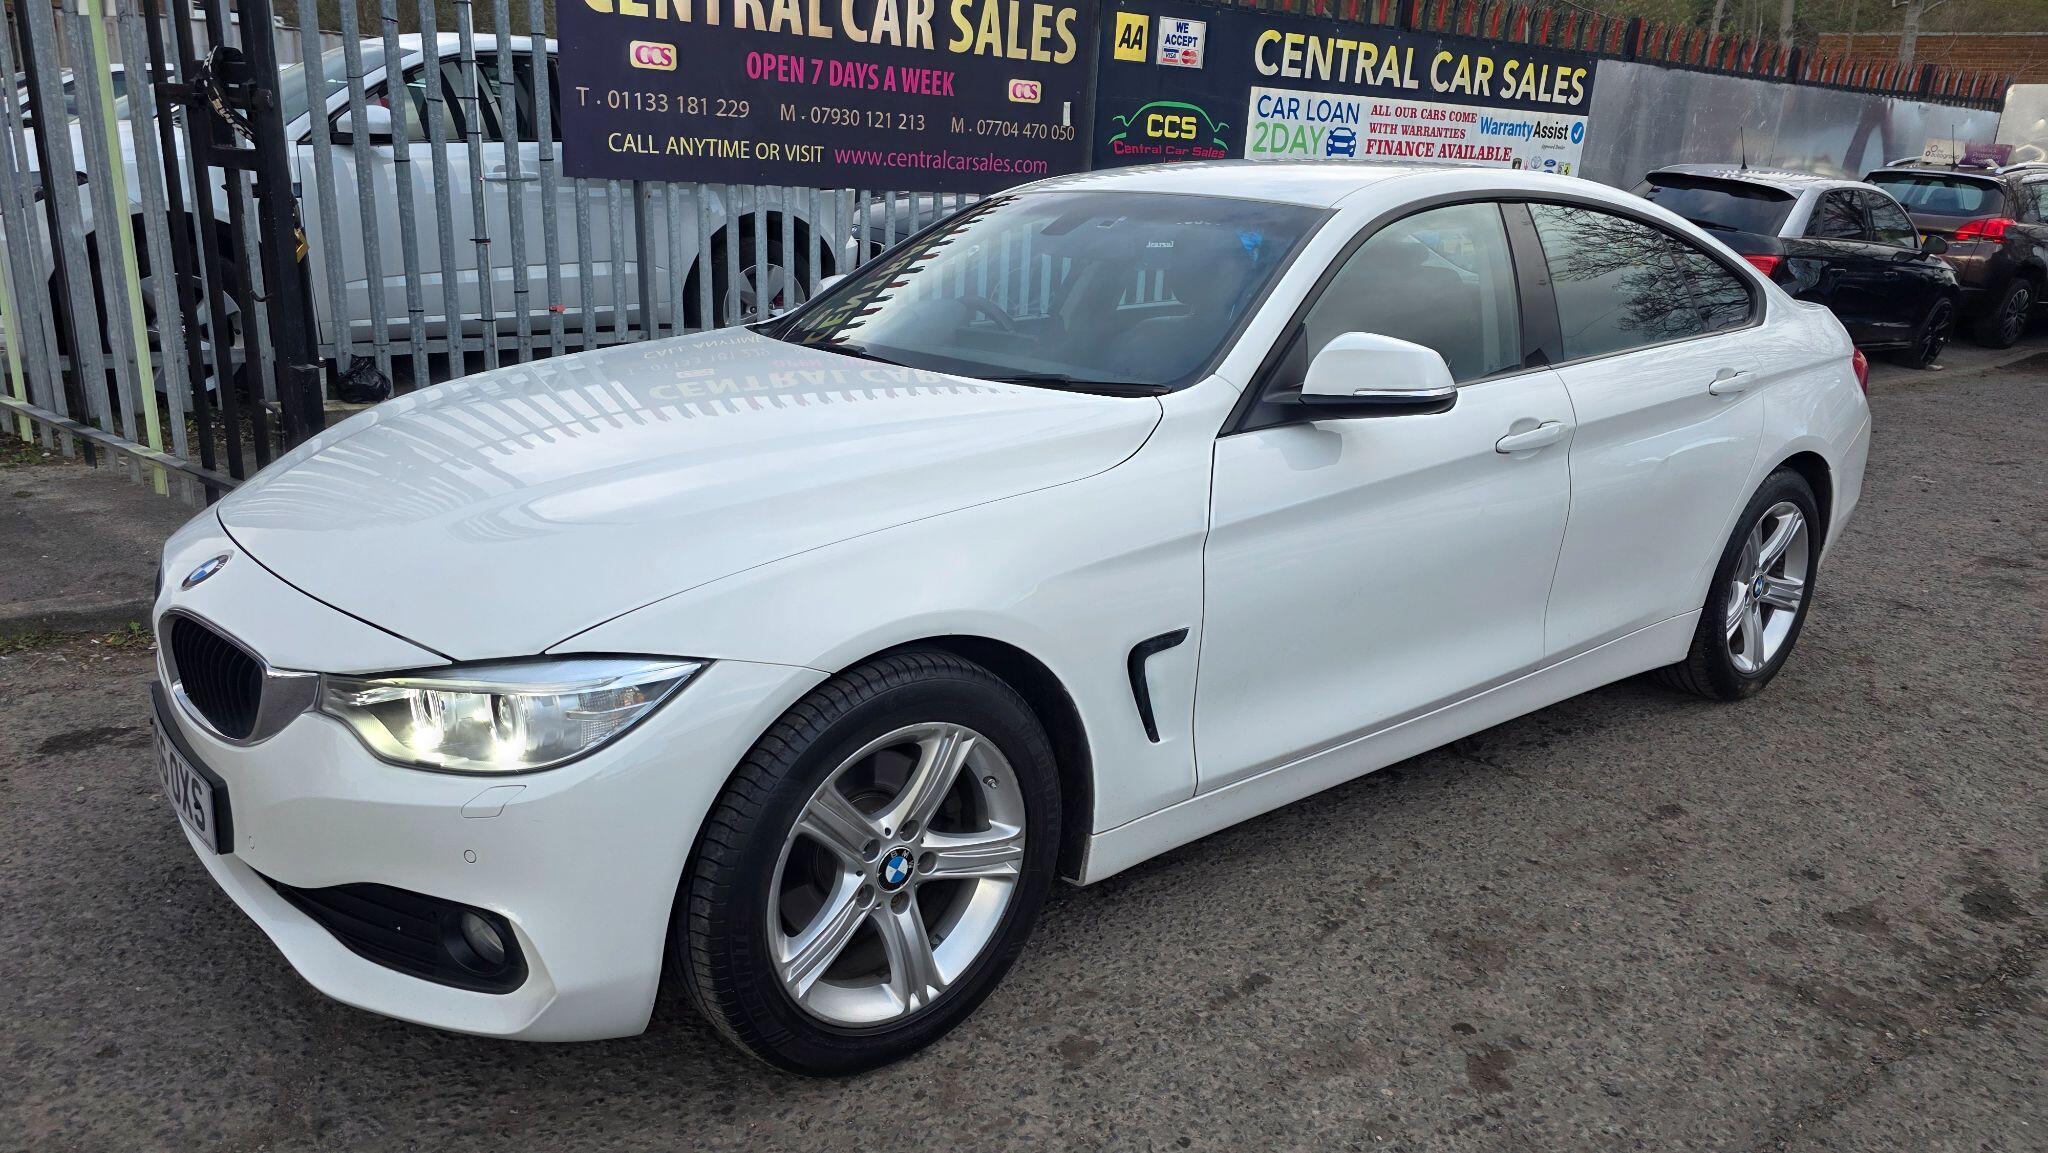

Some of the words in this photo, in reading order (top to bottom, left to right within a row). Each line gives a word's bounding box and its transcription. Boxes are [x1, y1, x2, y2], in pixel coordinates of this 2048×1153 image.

[841, 0, 935, 50] CAR
[948, 0, 1078, 65] SALES
[1118, 23, 1143, 50] AA
[1176, 21, 1190, 34] WE
[1164, 33, 1198, 48] ACCEPT
[635, 45, 672, 66] CCS
[1254, 29, 1419, 89] CENTRAL
[1430, 50, 1494, 96] CAR
[1499, 59, 1588, 106] SALES
[746, 51, 804, 84] OPEN
[811, 59, 824, 85] 7
[829, 60, 879, 90] DAYS
[883, 66, 897, 92] A
[901, 67, 955, 96] WEEK
[607, 89, 669, 113] 01133
[676, 96, 708, 116] 181
[715, 98, 750, 119] 229
[1012, 83, 1038, 100] CCS
[810, 106, 860, 127] 07930
[865, 110, 892, 129] 121
[898, 113, 926, 131] 213
[1257, 94, 1300, 120] CAR
[1306, 98, 1360, 125] LOAN
[1371, 104, 1391, 117] ALL
[1394, 106, 1417, 119] OUR
[1420, 108, 1446, 121] CARS
[1448, 110, 1477, 123] COME
[977, 119, 1019, 138] 07704
[1022, 122, 1048, 139] 470
[1051, 124, 1075, 141] 050
[1146, 113, 1197, 139] CCS
[1252, 121, 1326, 155] 2DAY
[1369, 122, 1398, 135] WITH
[1401, 124, 1466, 140] WARRANTIES
[608, 132, 660, 154] CALL
[665, 136, 750, 159] ANYTIME
[755, 142, 780, 161] OR
[784, 144, 824, 163] VISIT
[834, 149, 1048, 174] www.centralcarsales.com
[1113, 140, 1162, 155] Central
[1165, 145, 1189, 155] Car
[1191, 146, 1226, 159] Sales
[1365, 138, 1435, 158] FINANCE
[1437, 143, 1513, 162] AVAILABLE
